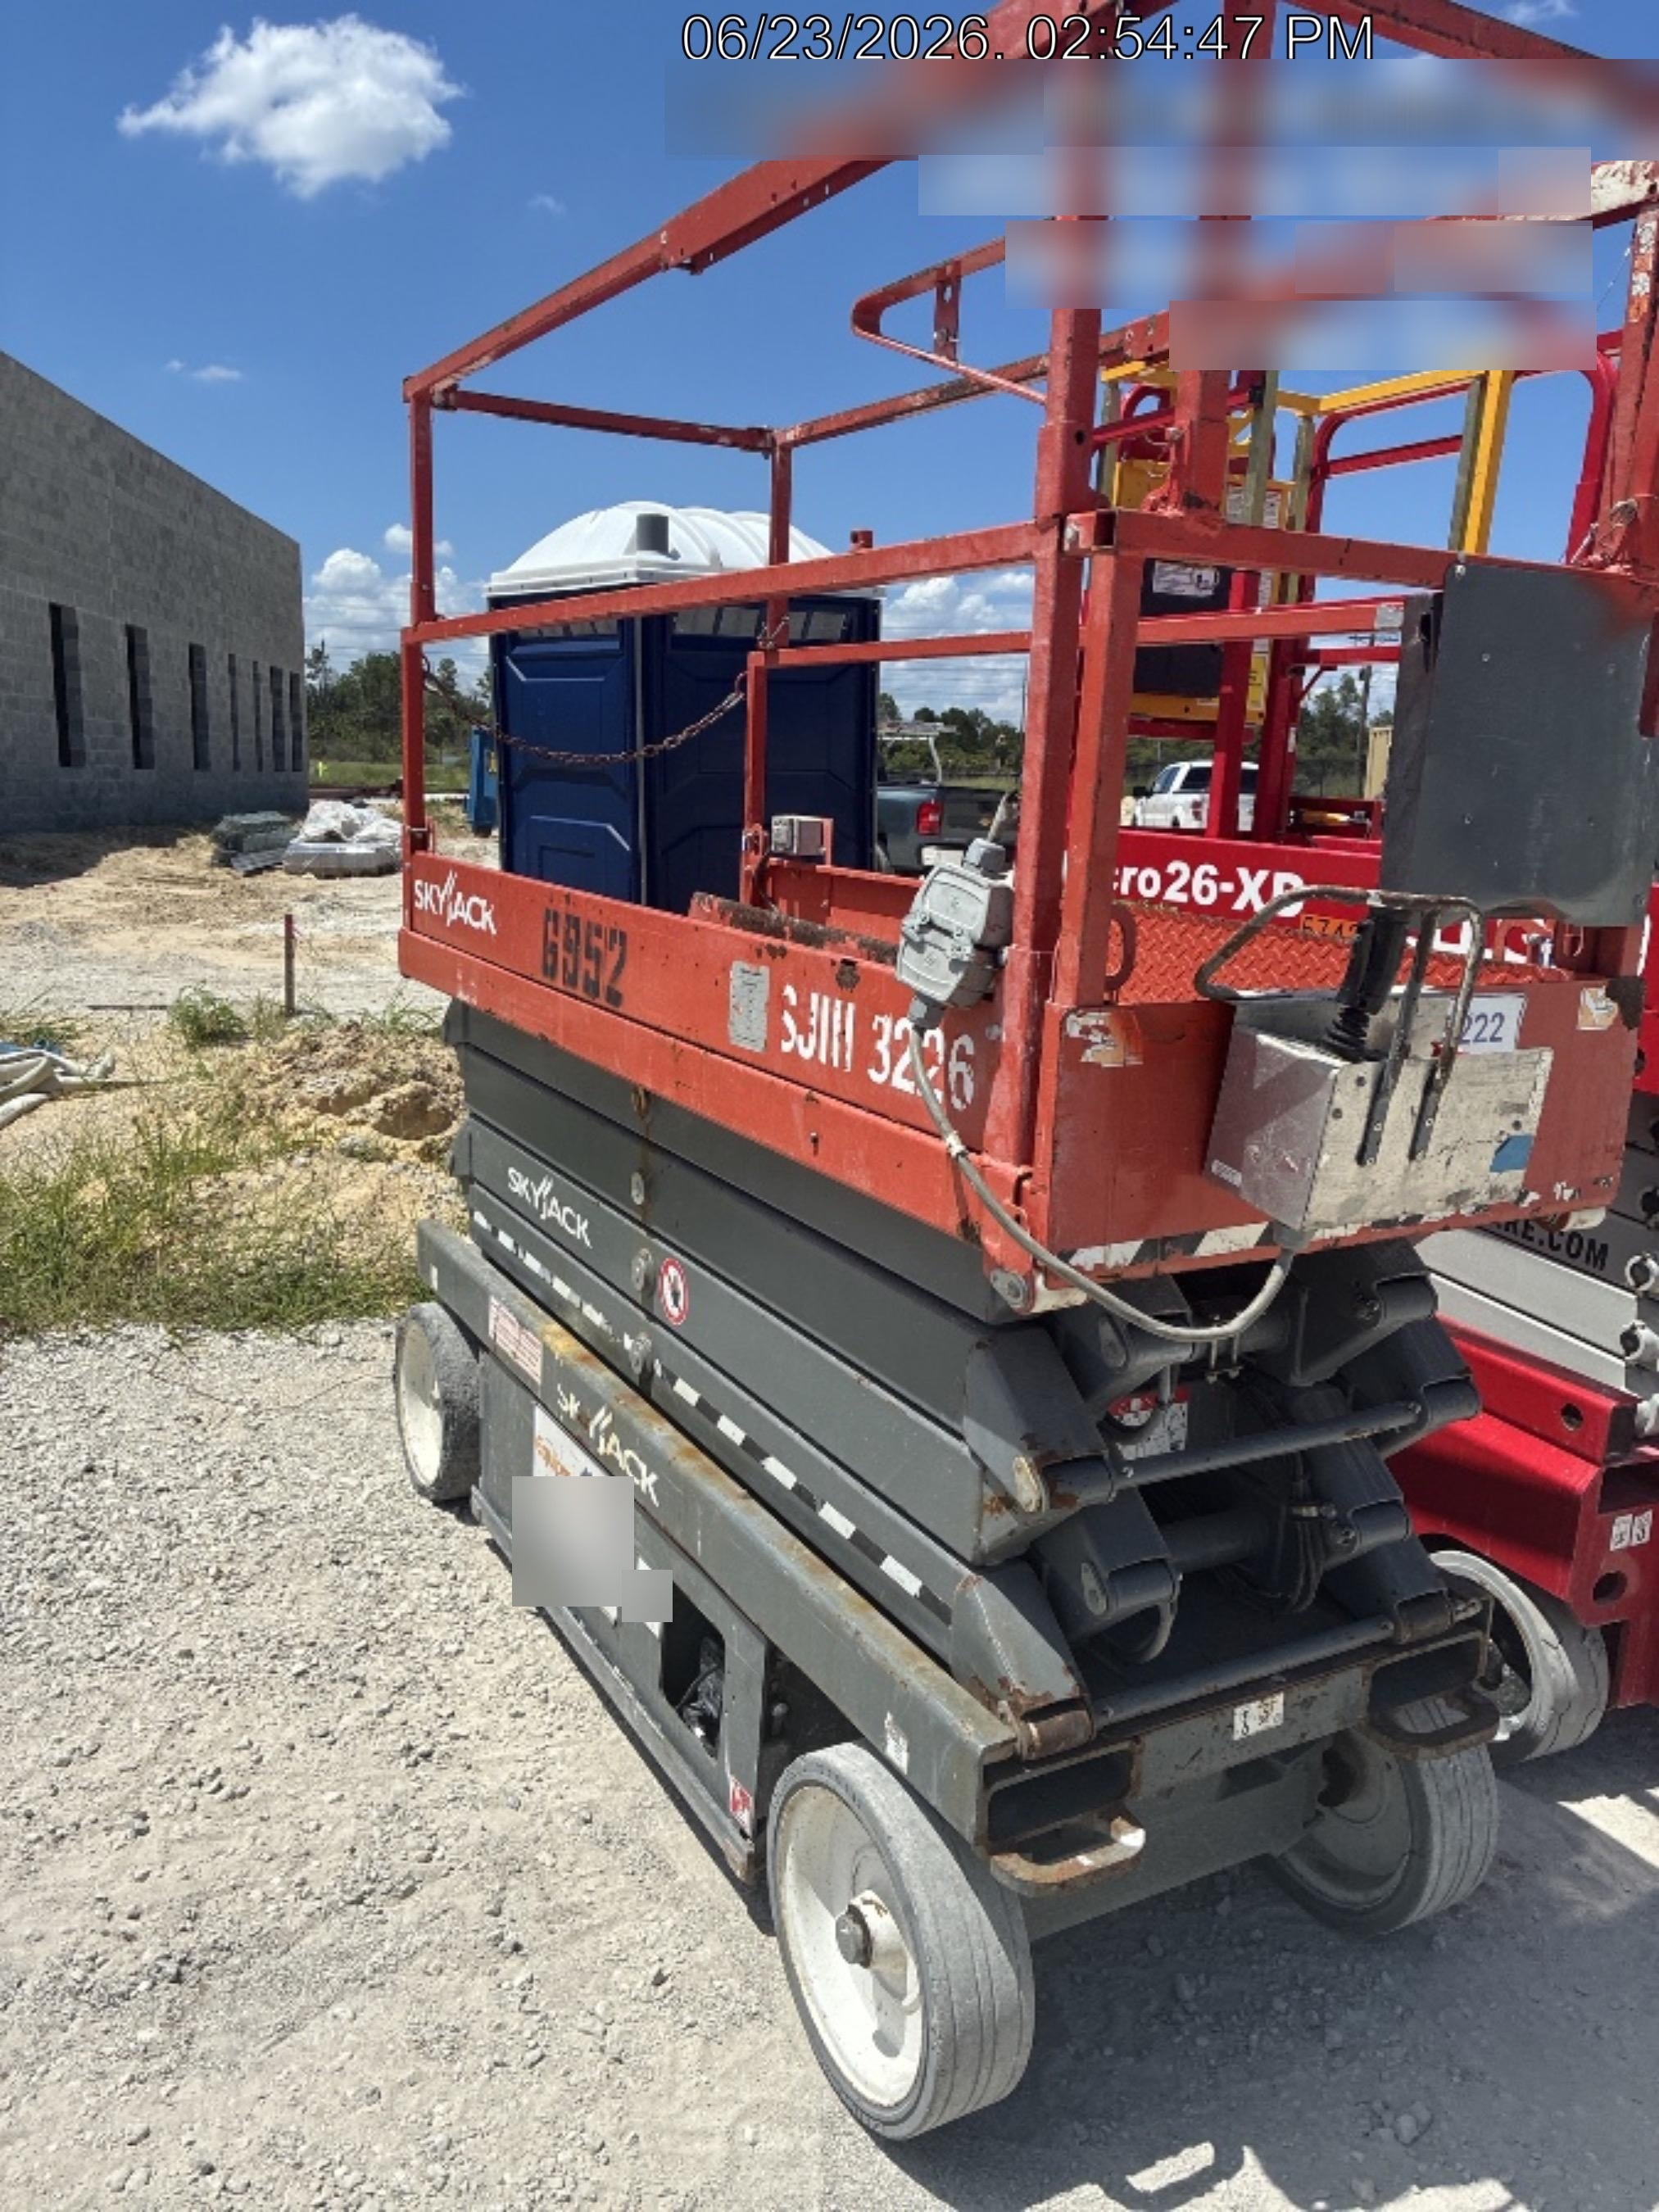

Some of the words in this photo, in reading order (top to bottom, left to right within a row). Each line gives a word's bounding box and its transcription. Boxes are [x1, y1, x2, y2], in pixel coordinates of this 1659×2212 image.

[414, 869, 496, 935] SKYJACK
[542, 907, 628, 1009] 6952
[867, 1013, 975, 1112] 3226
[508, 1167, 592, 1249] SKYJACK
